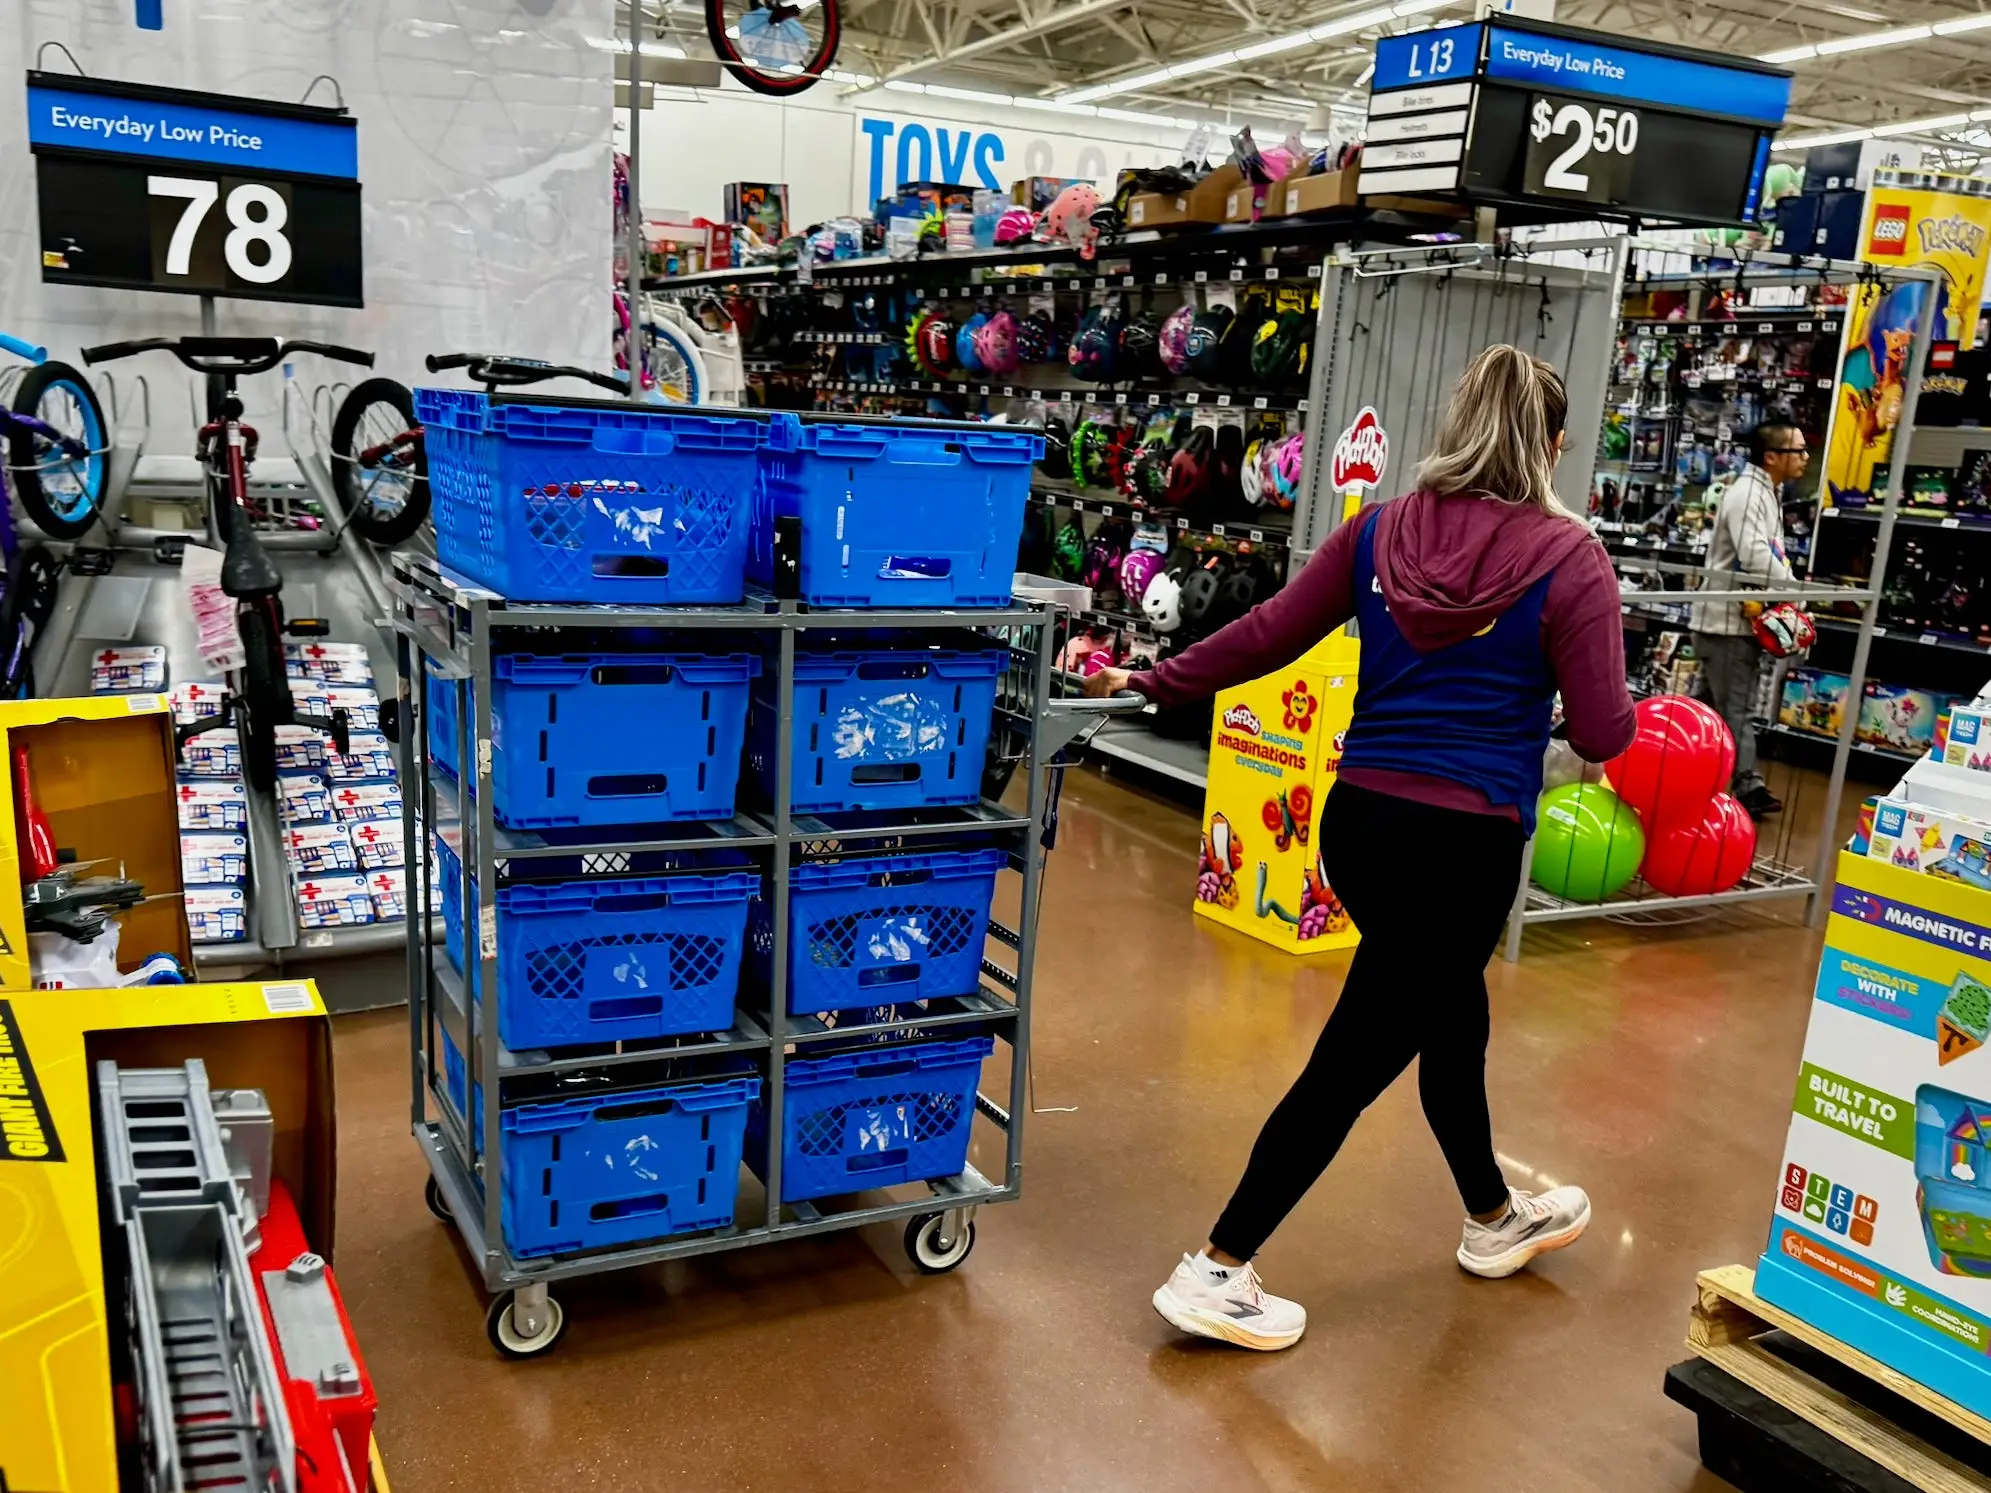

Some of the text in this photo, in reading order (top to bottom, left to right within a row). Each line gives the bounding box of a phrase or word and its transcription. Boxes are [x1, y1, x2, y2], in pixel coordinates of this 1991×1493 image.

[1409, 38, 1454, 78] L 13
[1503, 41, 1626, 80] Everyday Low Price
[51, 106, 263, 151] Everyday Low Price
[862, 118, 1005, 212] TOYS
[147, 175, 293, 284] 78
[1217, 731, 1307, 771] imaginations
[1885, 906, 1977, 947] MAGNETIC
[1840, 958, 1920, 996] DECORATE
[1857, 977, 1897, 1003] WITH
[1808, 1074, 1897, 1122] BUILT TO
[1814, 1096, 1885, 1141] TRAVEL
[0, 1097, 49, 1157] GIANT
